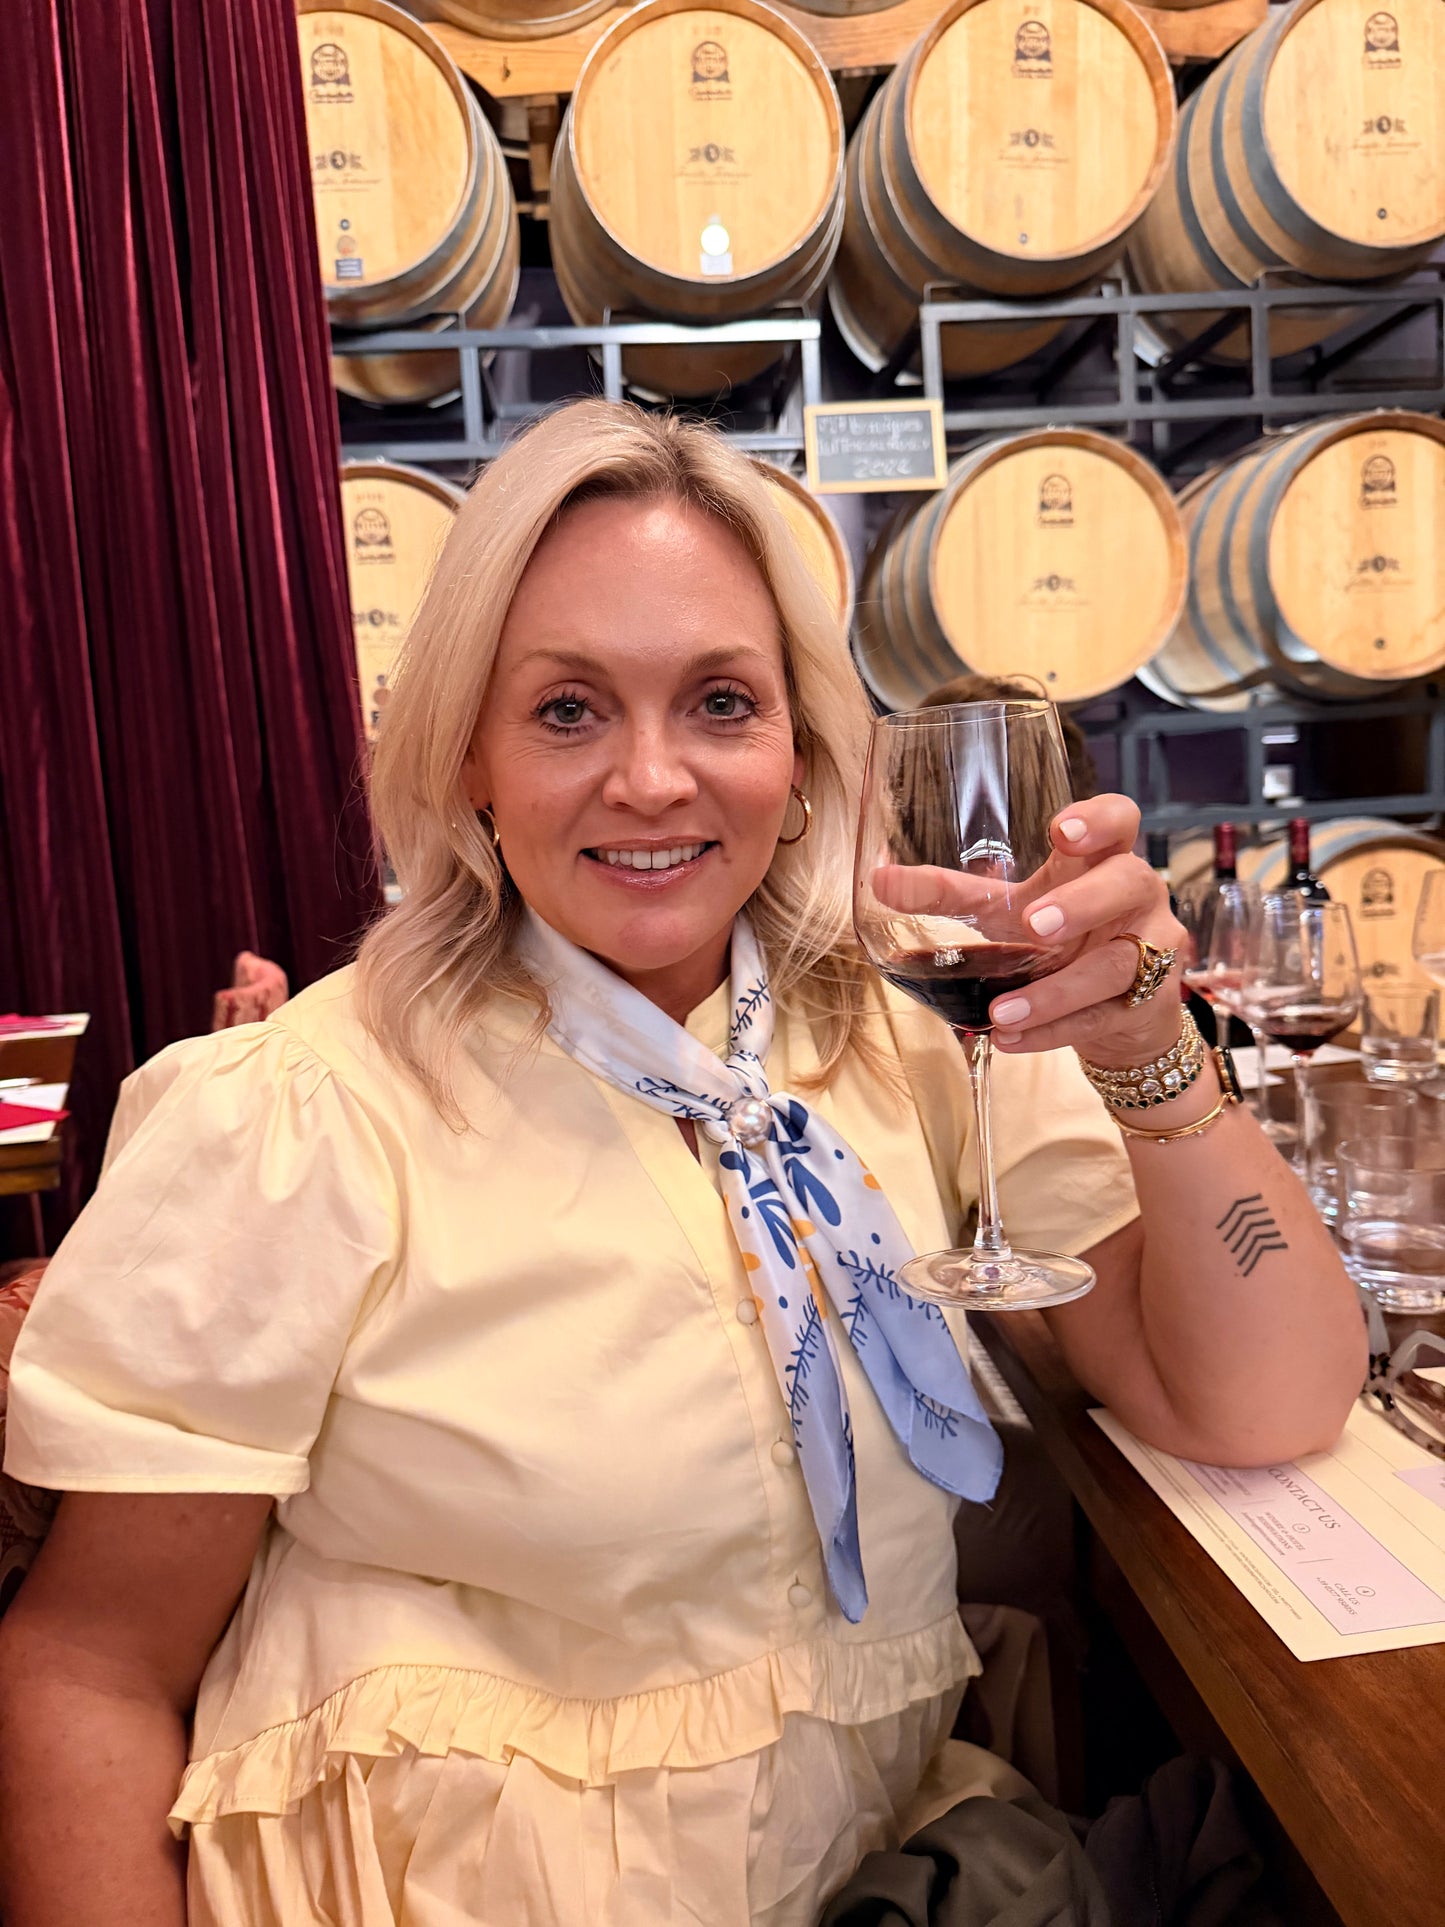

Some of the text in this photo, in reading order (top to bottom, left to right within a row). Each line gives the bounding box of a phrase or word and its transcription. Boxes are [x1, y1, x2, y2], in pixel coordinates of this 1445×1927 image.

[1267, 1468, 1325, 1512] CONTACT
[1318, 1514, 1341, 1529] US
[1334, 1582, 1352, 1597] CALL
